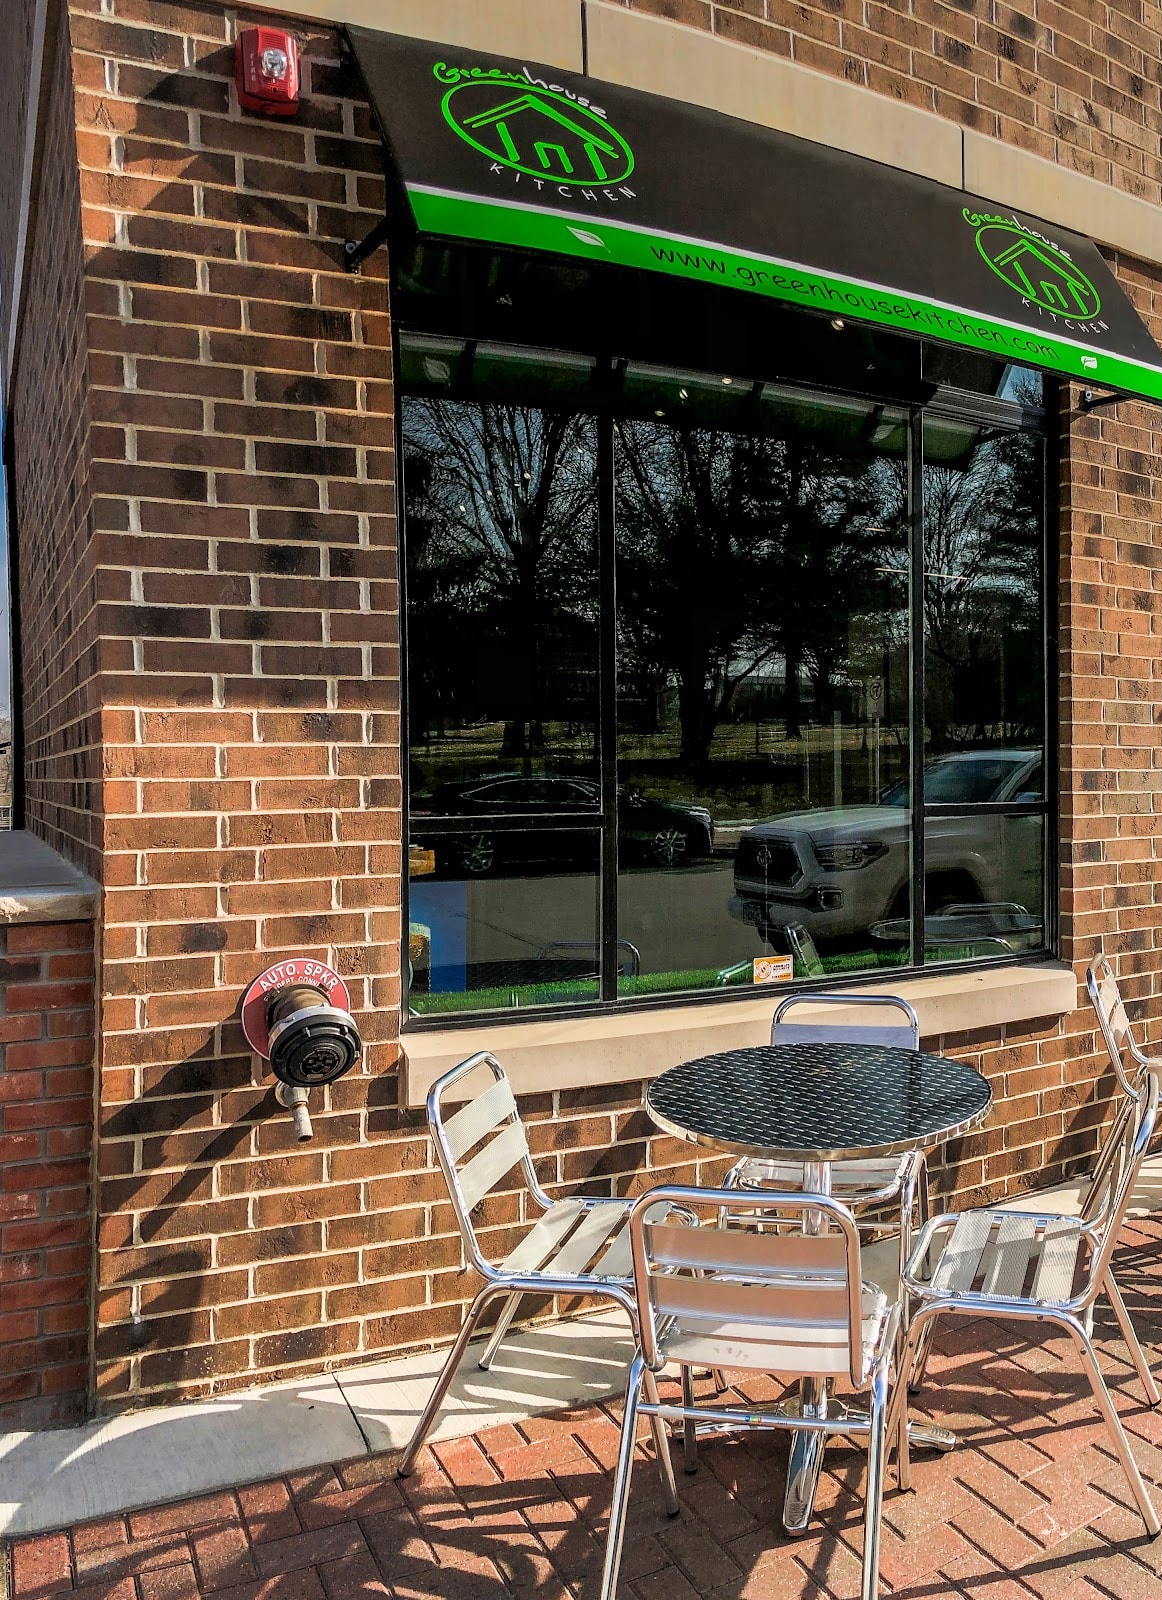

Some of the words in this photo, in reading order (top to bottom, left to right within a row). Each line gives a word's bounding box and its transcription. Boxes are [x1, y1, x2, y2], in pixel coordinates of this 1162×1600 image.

[433, 62, 608, 120] Greenhouse
[490, 162, 637, 202] KITCHEN
[962, 208, 1073, 262] Greenhouse
[649, 243, 1061, 362] www.greenhousekitchen.com
[1021, 296, 1110, 333] KITCHEN
[260, 963, 300, 992] AUTO.
[304, 962, 339, 993] SPKR.
